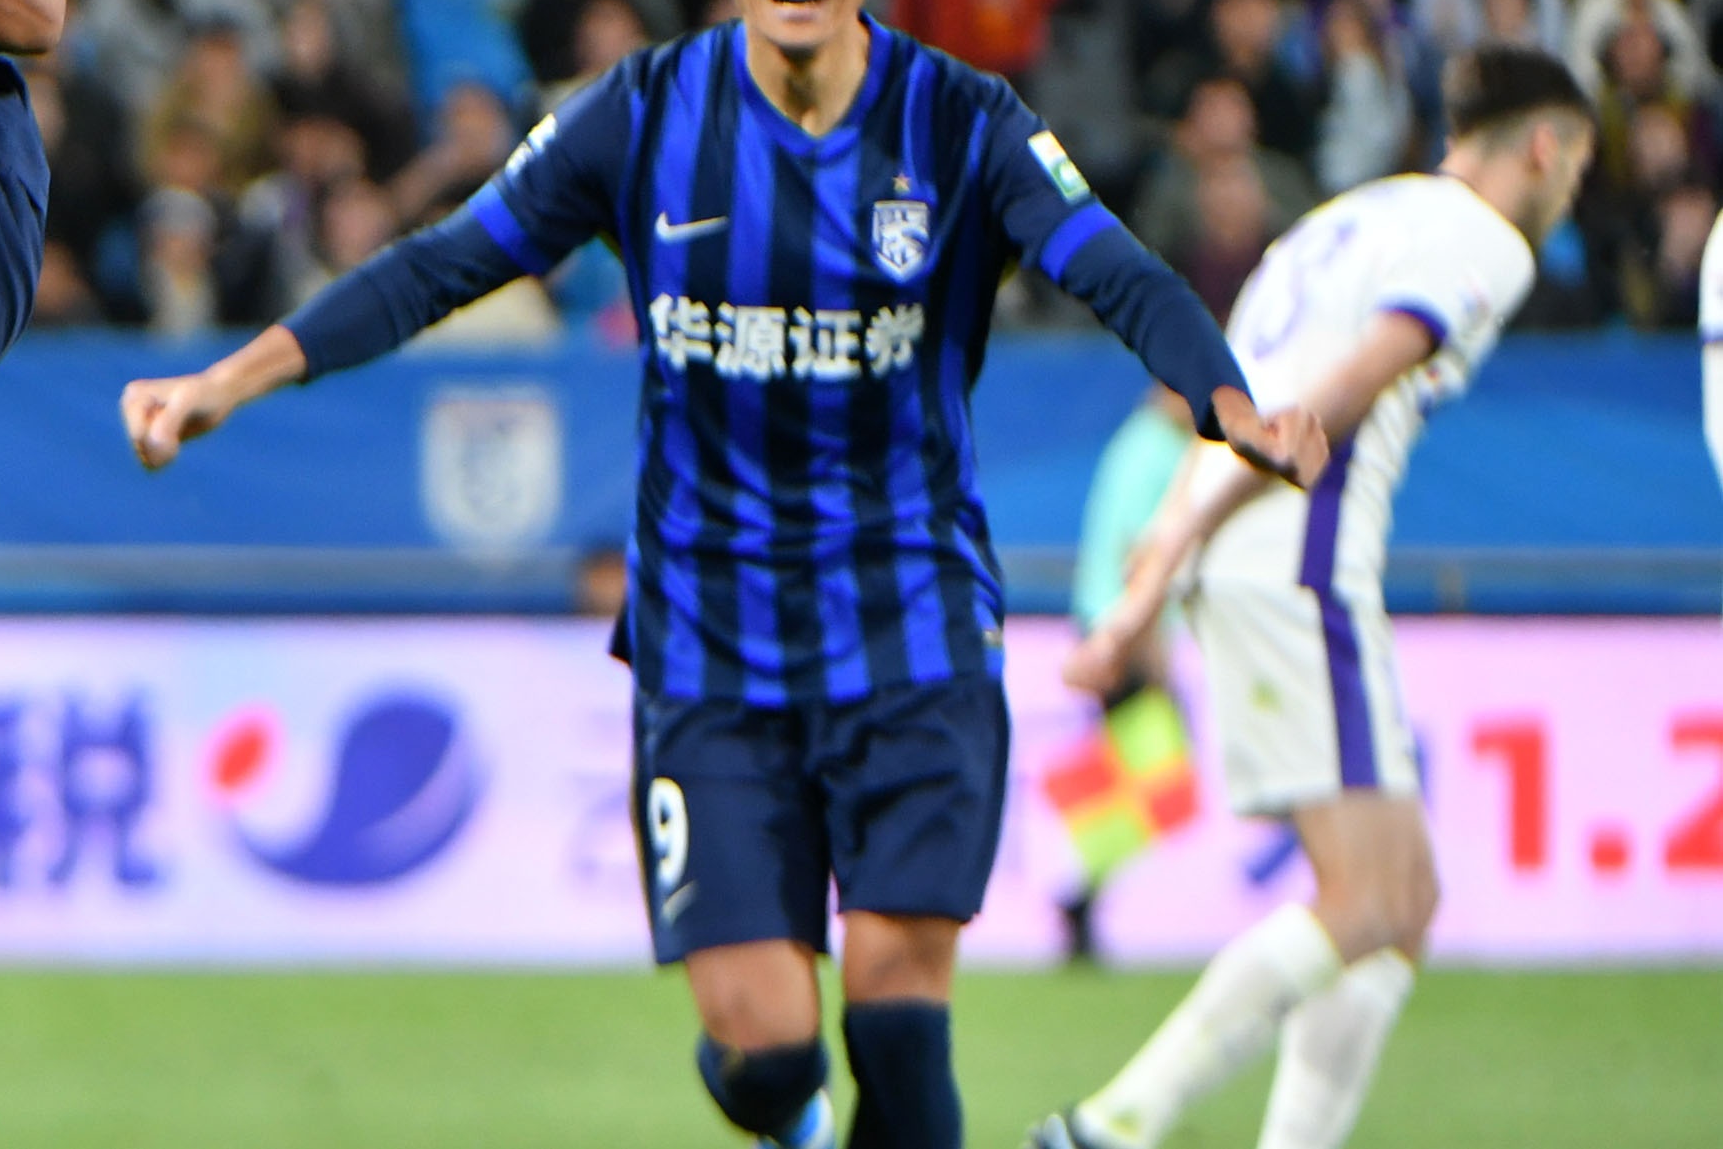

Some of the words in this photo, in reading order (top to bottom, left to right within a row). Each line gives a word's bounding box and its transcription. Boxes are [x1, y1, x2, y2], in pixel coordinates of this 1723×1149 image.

[649, 292, 926, 381] 华源证券
[647, 776, 690, 890] 9
